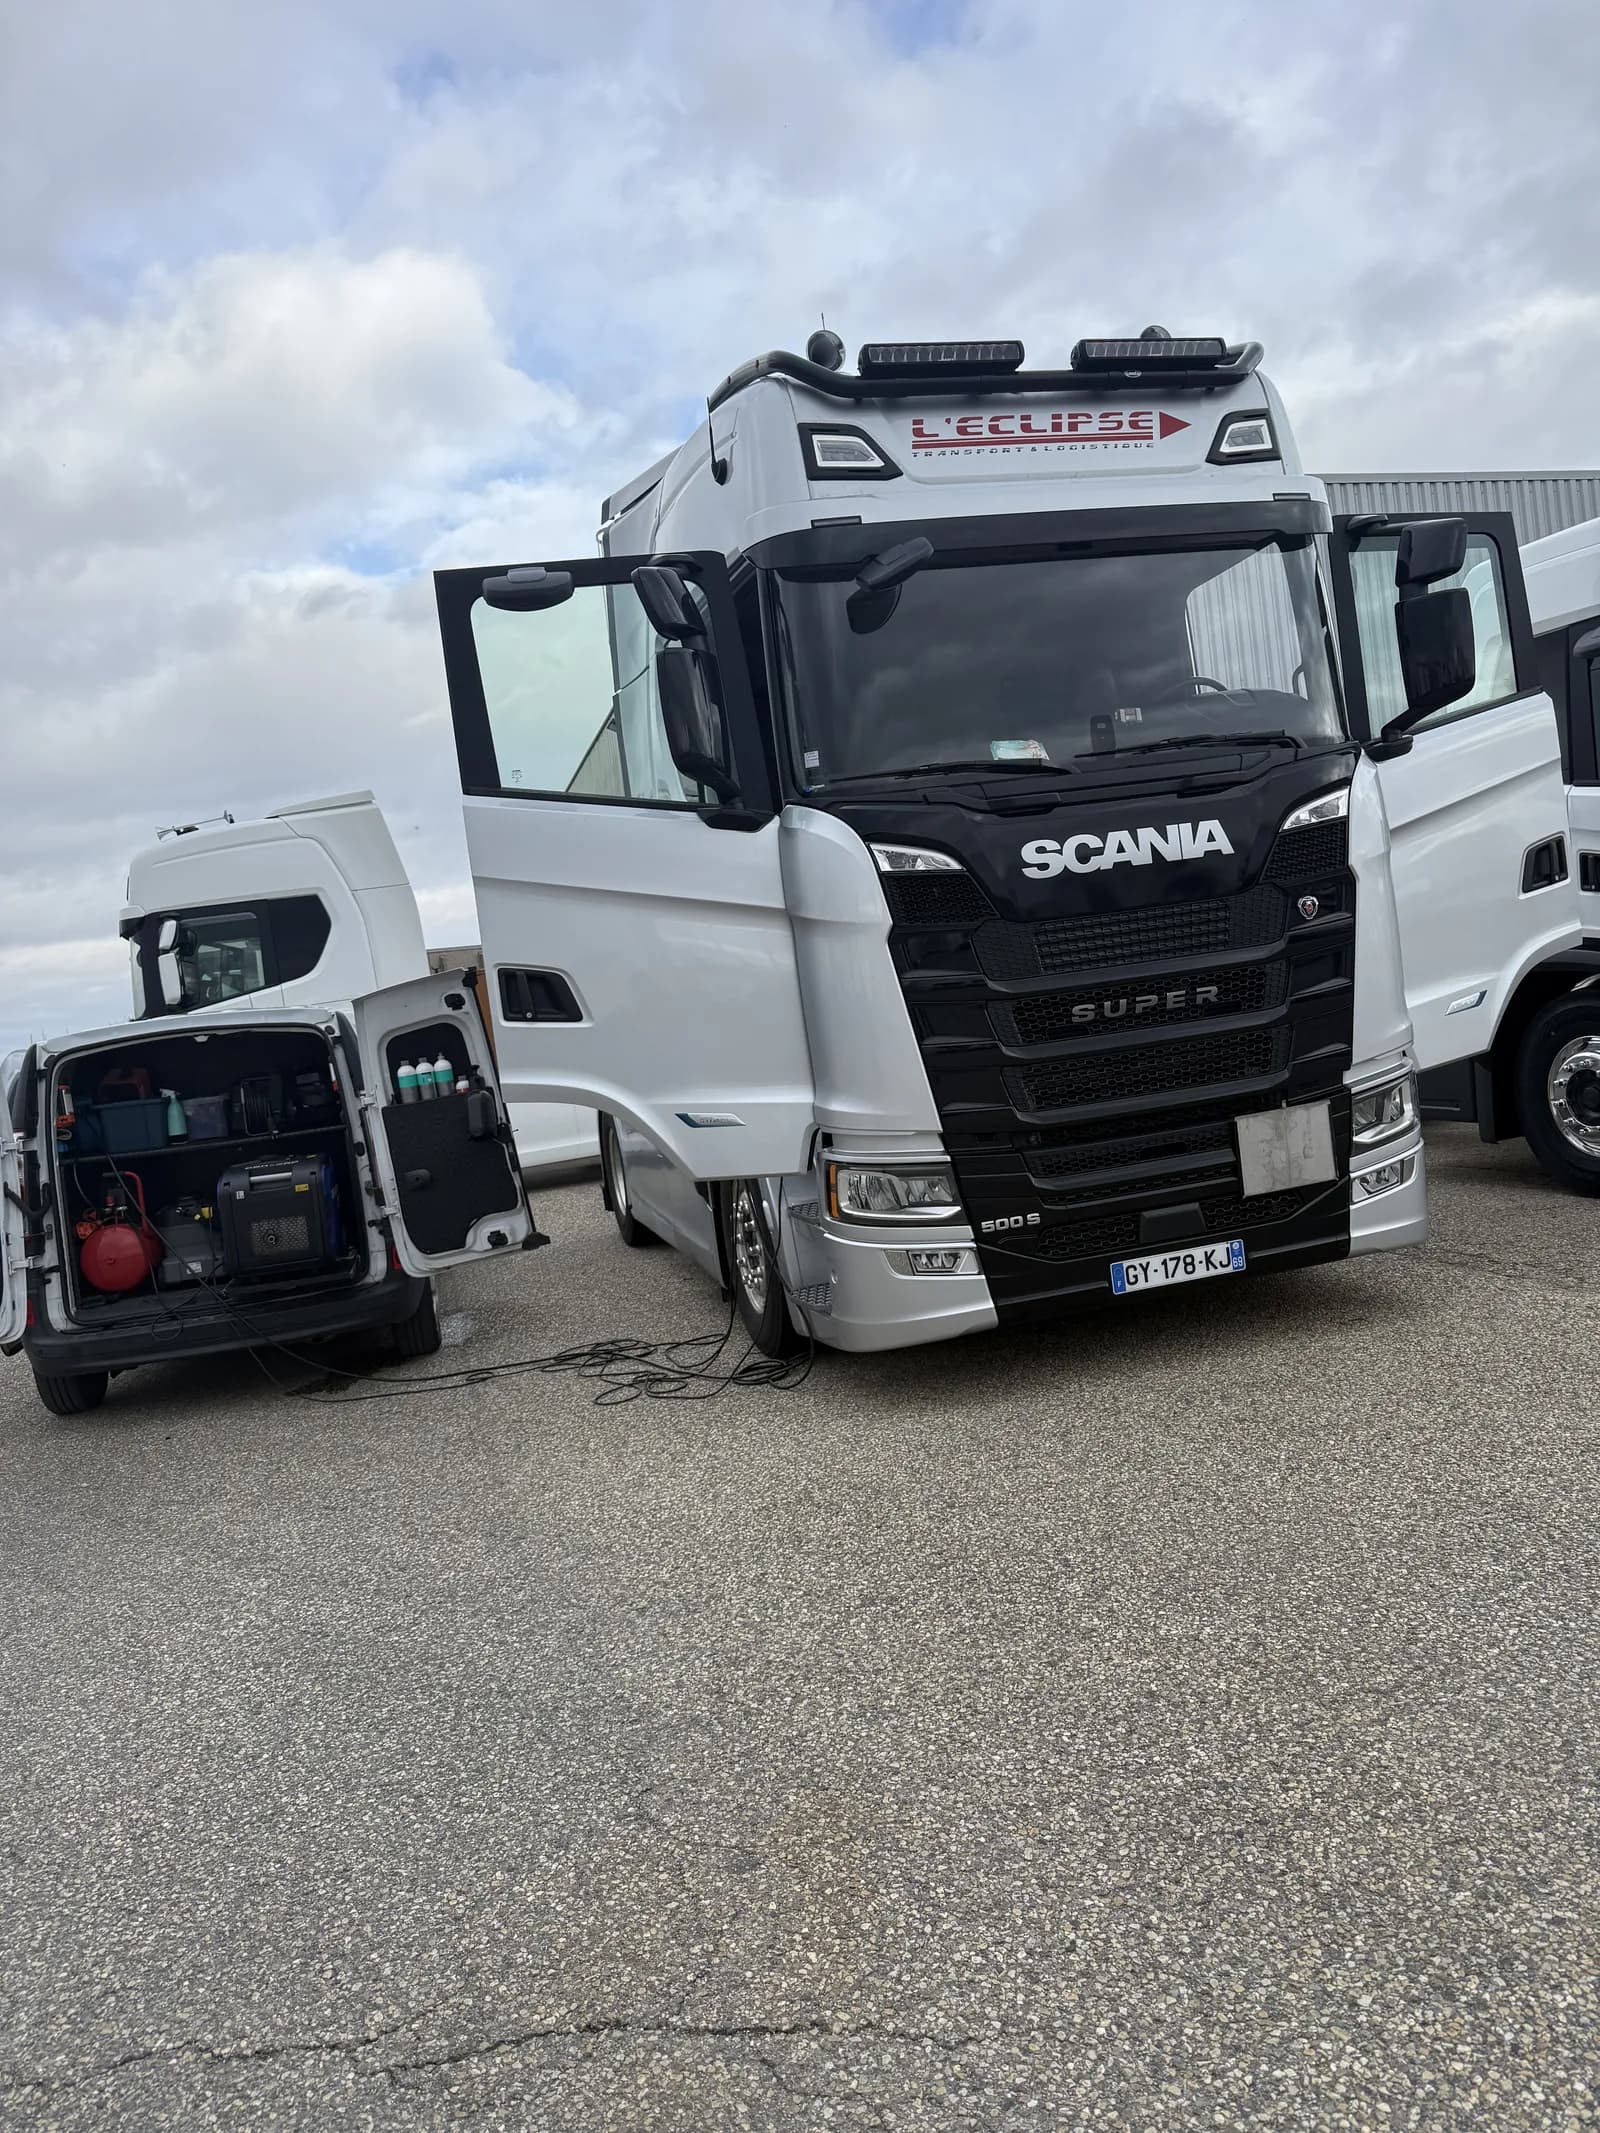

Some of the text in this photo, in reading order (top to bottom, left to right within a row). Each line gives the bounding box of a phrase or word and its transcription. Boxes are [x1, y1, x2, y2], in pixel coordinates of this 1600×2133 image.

[911, 411, 1154, 438] L'ECLIPSE
[1021, 819, 1235, 879] SCANIA
[1071, 985, 1219, 1023] SUPER
[1125, 1246, 1231, 1286] GY-178-KJ
[1232, 1256, 1243, 1268] 69
